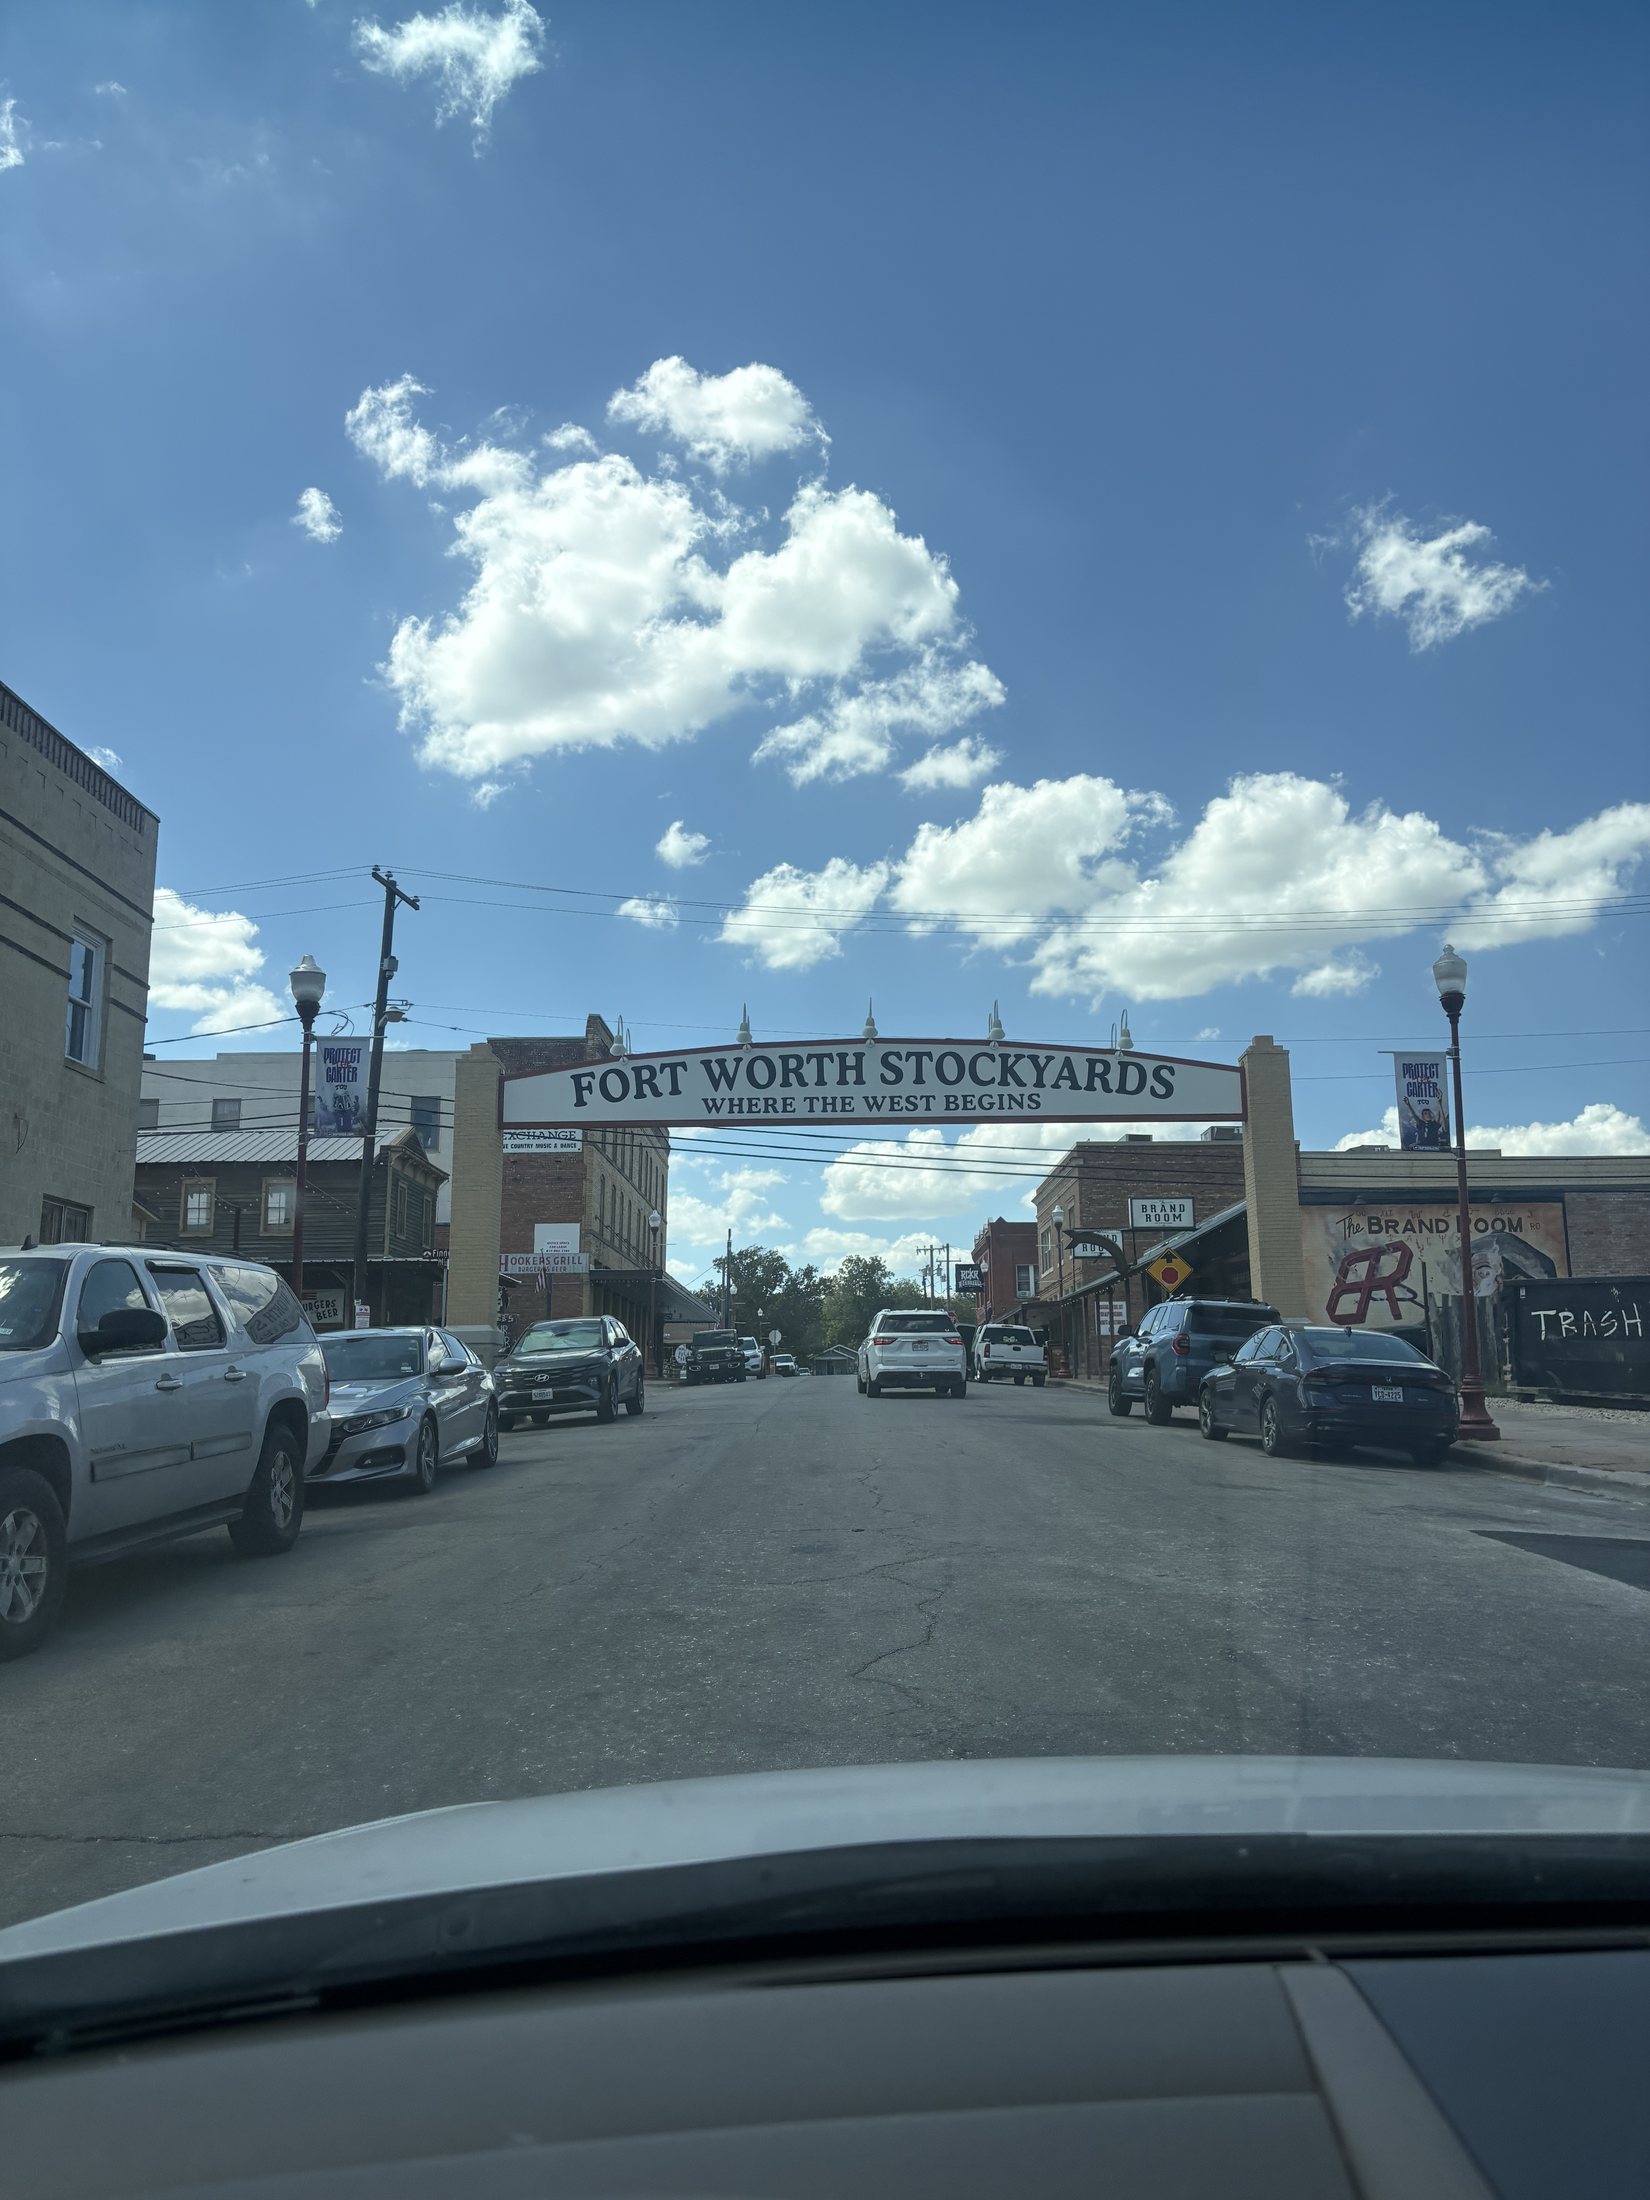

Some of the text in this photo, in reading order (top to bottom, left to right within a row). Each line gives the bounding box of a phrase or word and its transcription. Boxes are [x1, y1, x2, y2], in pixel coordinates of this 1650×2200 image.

[324, 1047, 362, 1065] PROTECT
[326, 1067, 357, 1082] CARTER
[570, 1050, 1176, 1108] FORT WORTH STOCKYARDS
[1402, 1063, 1439, 1080] PROTECT
[1406, 1081, 1438, 1098] CARTER
[701, 1092, 1041, 1114] WHERE THE WEST BEGINS
[503, 1130, 577, 1141] XCHANGE
[1141, 1203, 1185, 1213] BRAND
[1145, 1213, 1182, 1222] ROOM
[1336, 1212, 1364, 1240] The
[1367, 1215, 1450, 1235] BRAND
[499, 1255, 582, 1272] HOOKERS GRILL
[302, 1299, 337, 1312] URGERS
[316, 1308, 338, 1321] BEER
[1531, 1302, 1642, 1340] TRASH
